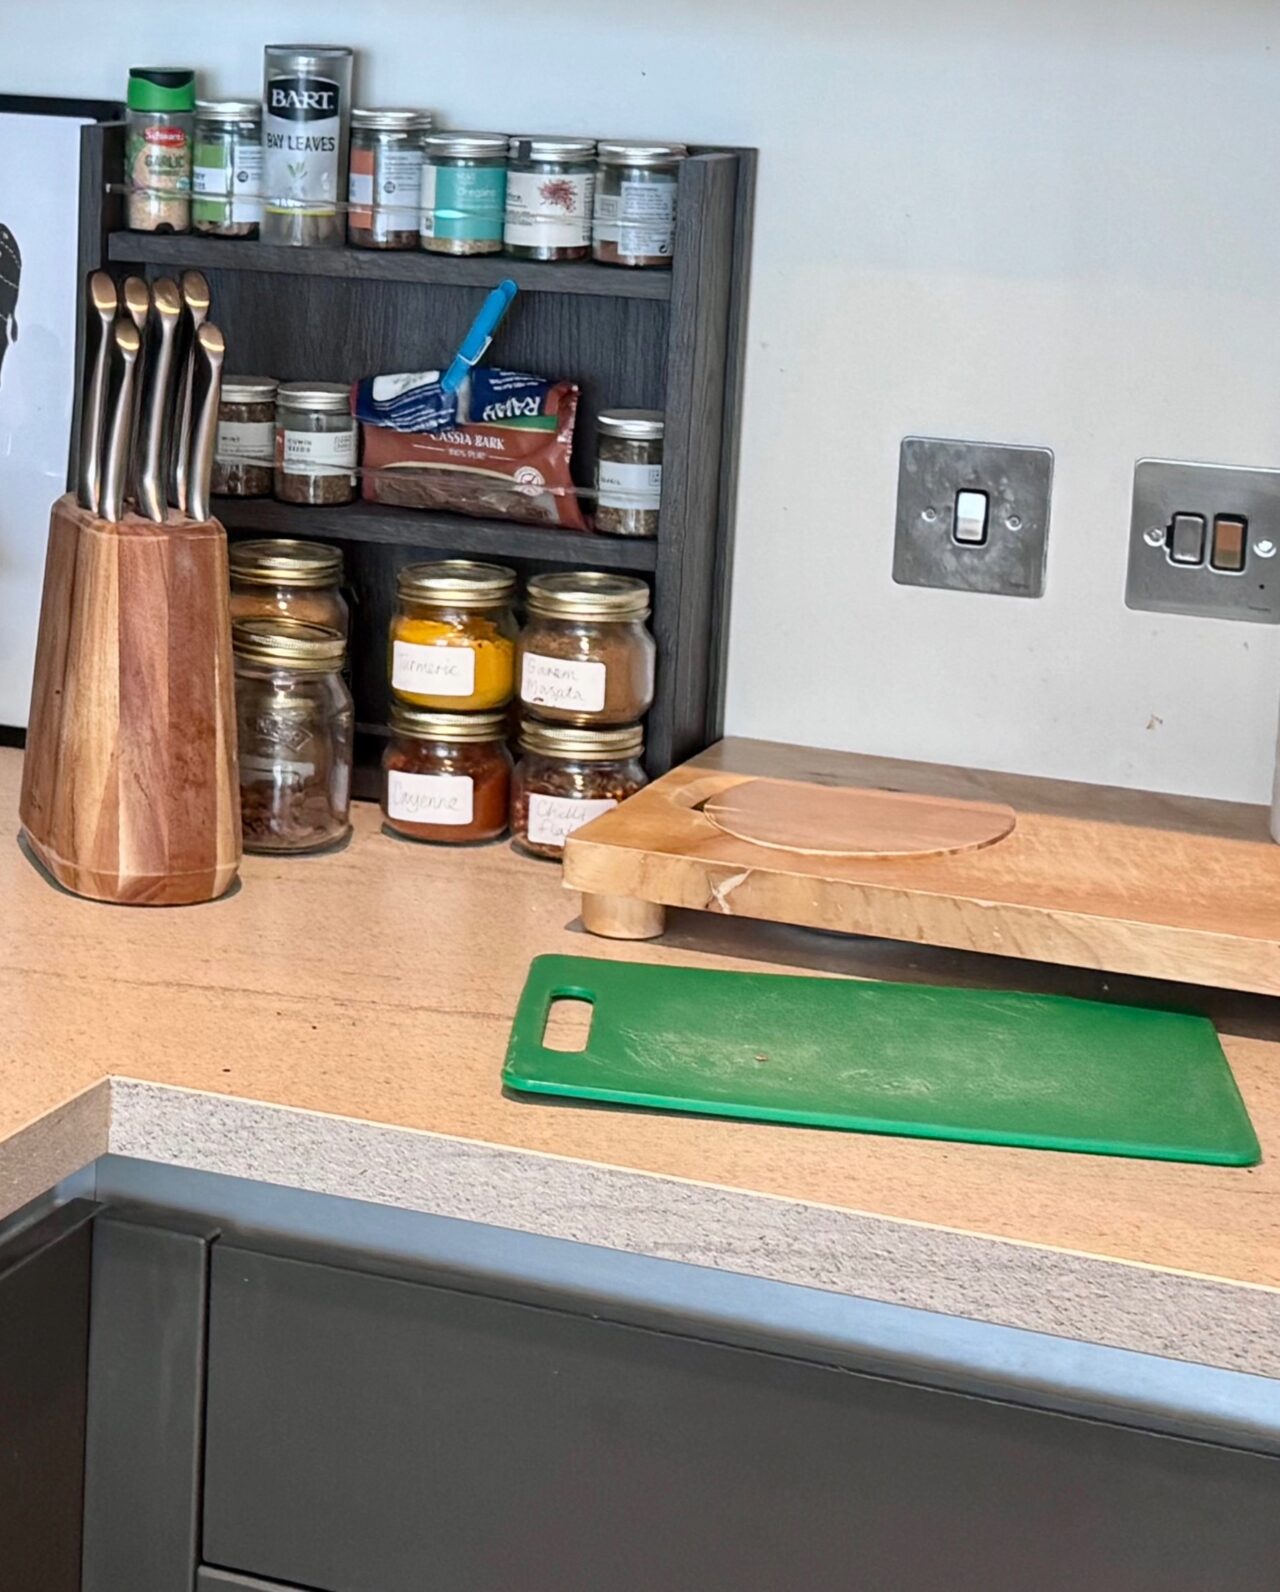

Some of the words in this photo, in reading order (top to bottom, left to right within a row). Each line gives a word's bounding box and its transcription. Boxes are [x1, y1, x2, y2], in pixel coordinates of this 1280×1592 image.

[271, 88, 334, 109] BART
[267, 132, 284, 149] BAY
[288, 135, 335, 152] LEAVES
[474, 434, 505, 450] BARK
[399, 652, 459, 677] Turmeric
